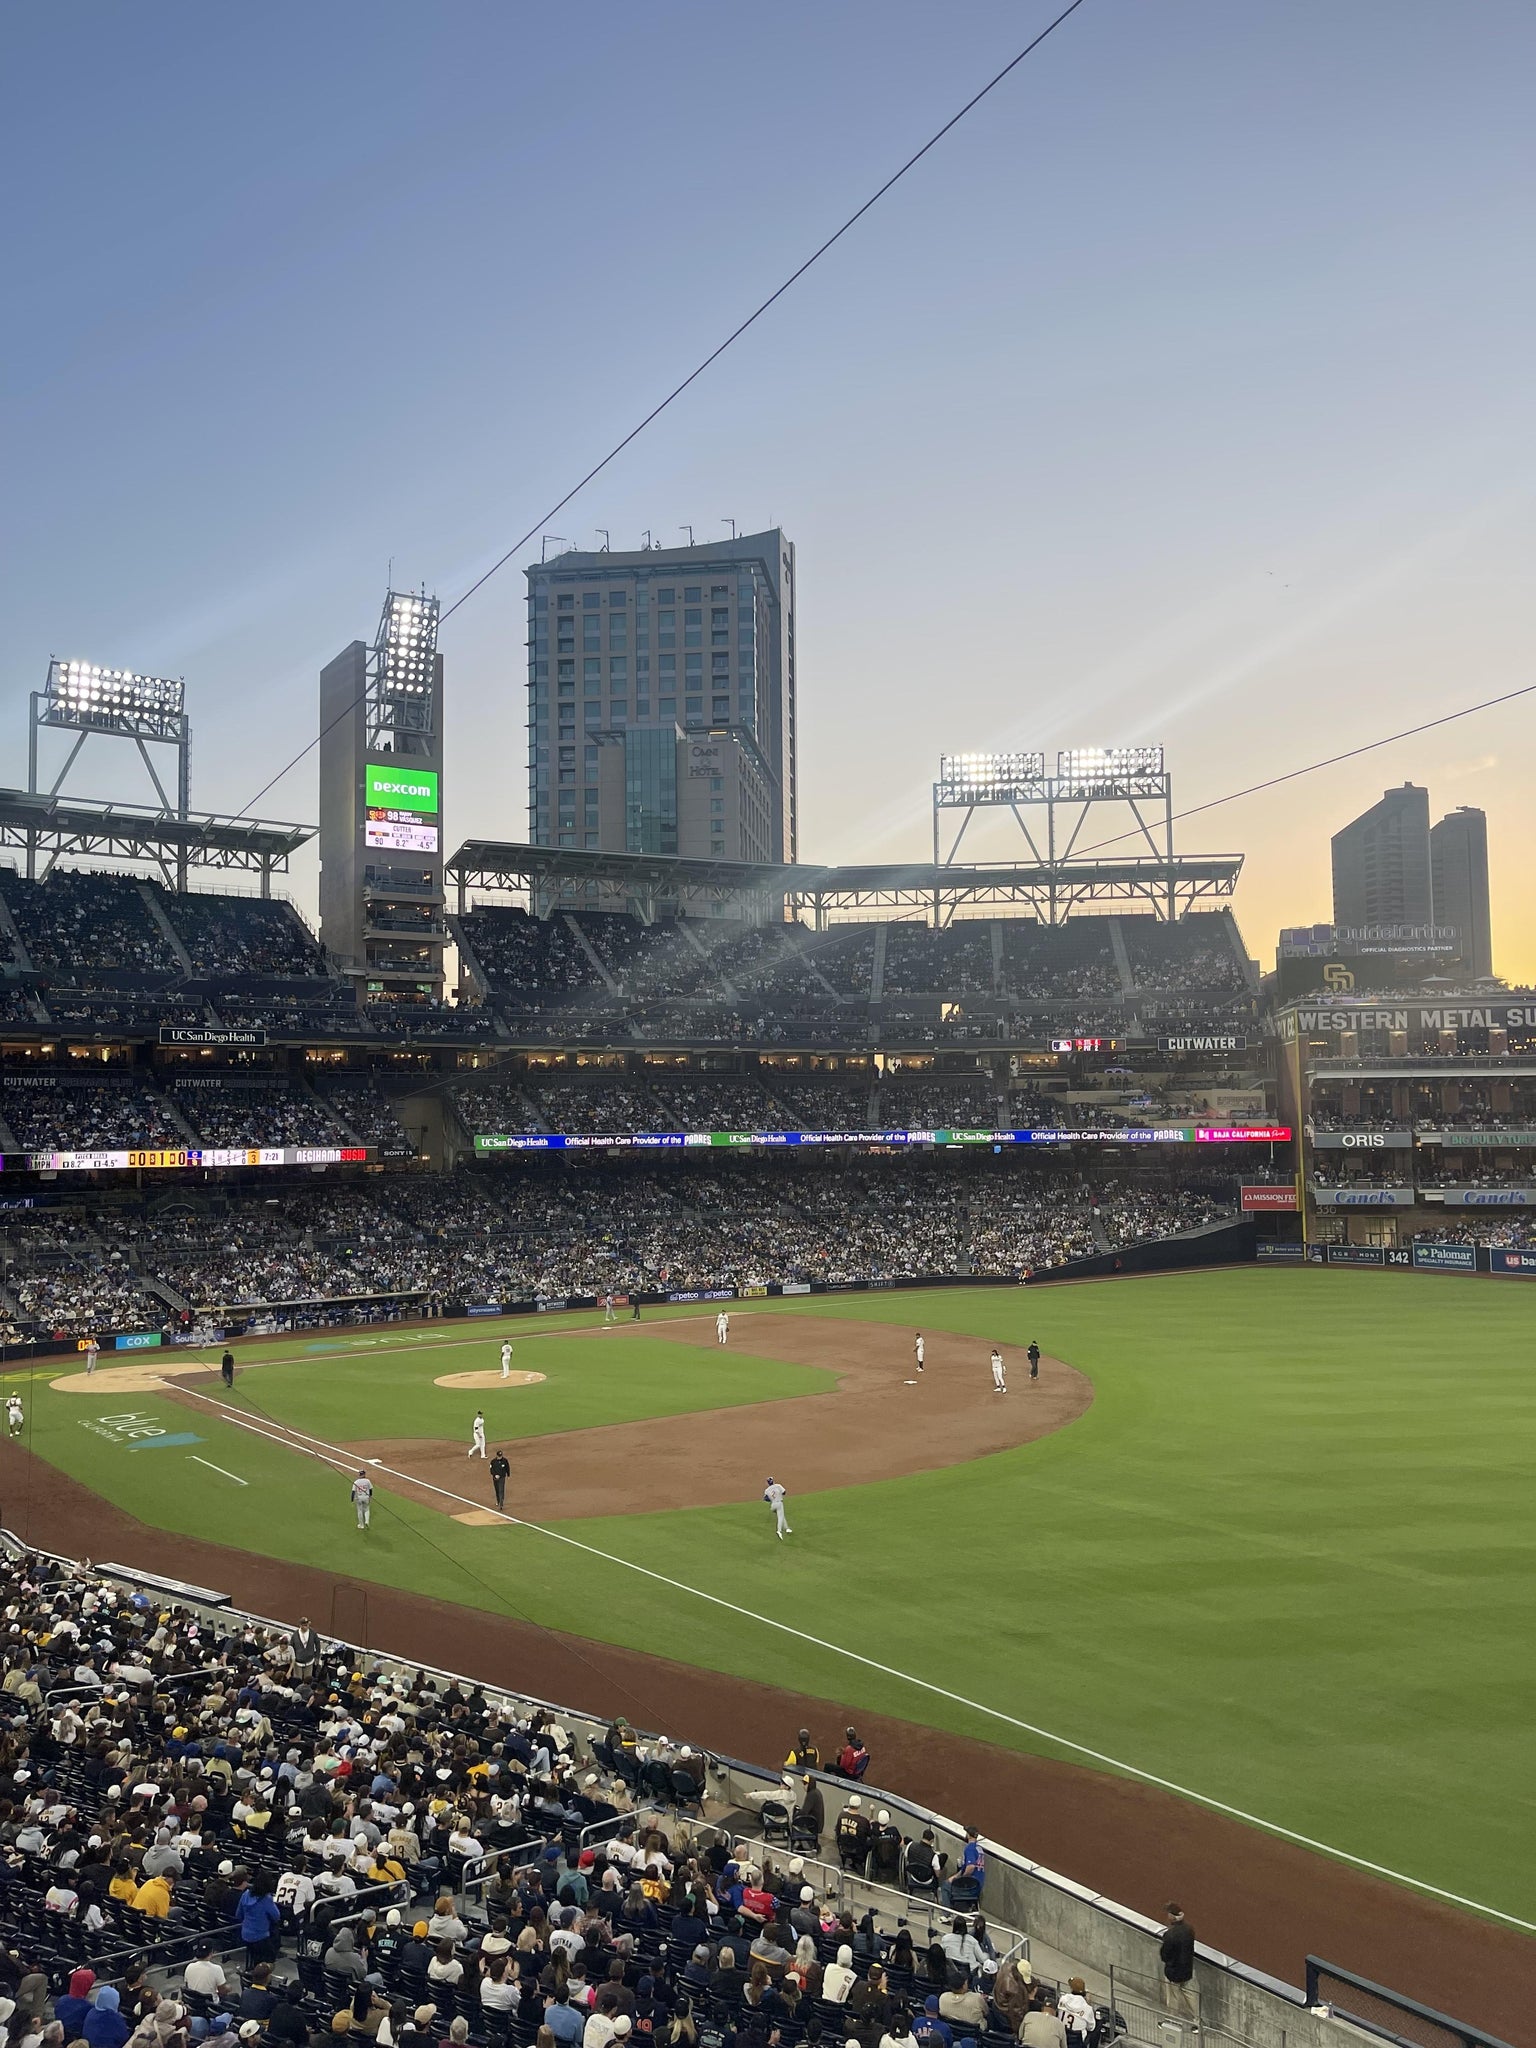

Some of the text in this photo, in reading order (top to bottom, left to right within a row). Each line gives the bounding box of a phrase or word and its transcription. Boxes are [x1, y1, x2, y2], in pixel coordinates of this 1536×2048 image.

[373, 781, 431, 797] Dexcom
[387, 811, 399, 821] 98
[374, 836, 384, 846] 90
[1336, 923, 1457, 944] QuidelOrtho
[1297, 1010, 1408, 1031] WESTERN
[1420, 1009, 1500, 1028] METAL
[171, 1031, 256, 1043] UC San Diego Health
[1168, 1037, 1236, 1050] CUTWATER
[3, 1077, 56, 1087] CUTWATER
[175, 1078, 221, 1088] CUTWATER
[729, 1134, 787, 1144] UC San Diego Health
[800, 1132, 935, 1142] Official Health Care Provider of the PADRES
[952, 1132, 1015, 1141] UC San Diego Health
[1031, 1129, 1184, 1141] Official Health Care Provider of the PADRES
[1231, 1130, 1271, 1138] CALIFORNIA
[1451, 1135, 1469, 1145] BIG
[1472, 1134, 1505, 1145] BULLY
[481, 1137, 548, 1148] UC San Diego Health
[564, 1134, 712, 1146] Official Health Care Provider of the PADRES
[1342, 1134, 1385, 1147] ORIS
[139, 1152, 146, 1166] 0
[160, 1152, 164, 1166] 1
[178, 1151, 185, 1166] 0
[251, 1155, 257, 1164] 3
[264, 1152, 279, 1161] 7:21
[34, 1160, 51, 1169] MPH
[1335, 1191, 1396, 1204] Canel's
[1463, 1191, 1527, 1204] Canel's
[1389, 1251, 1409, 1264] 342
[1430, 1248, 1472, 1260] Palomar
[1418, 1257, 1472, 1266] SPECIALTY INSURANCE
[1506, 1255, 1536, 1266] us ba
[678, 1291, 699, 1301] petco
[712, 1289, 733, 1299] petco
[126, 1336, 150, 1347] COX
[97, 1411, 167, 1438] blue
[276, 1887, 297, 1905] 23
